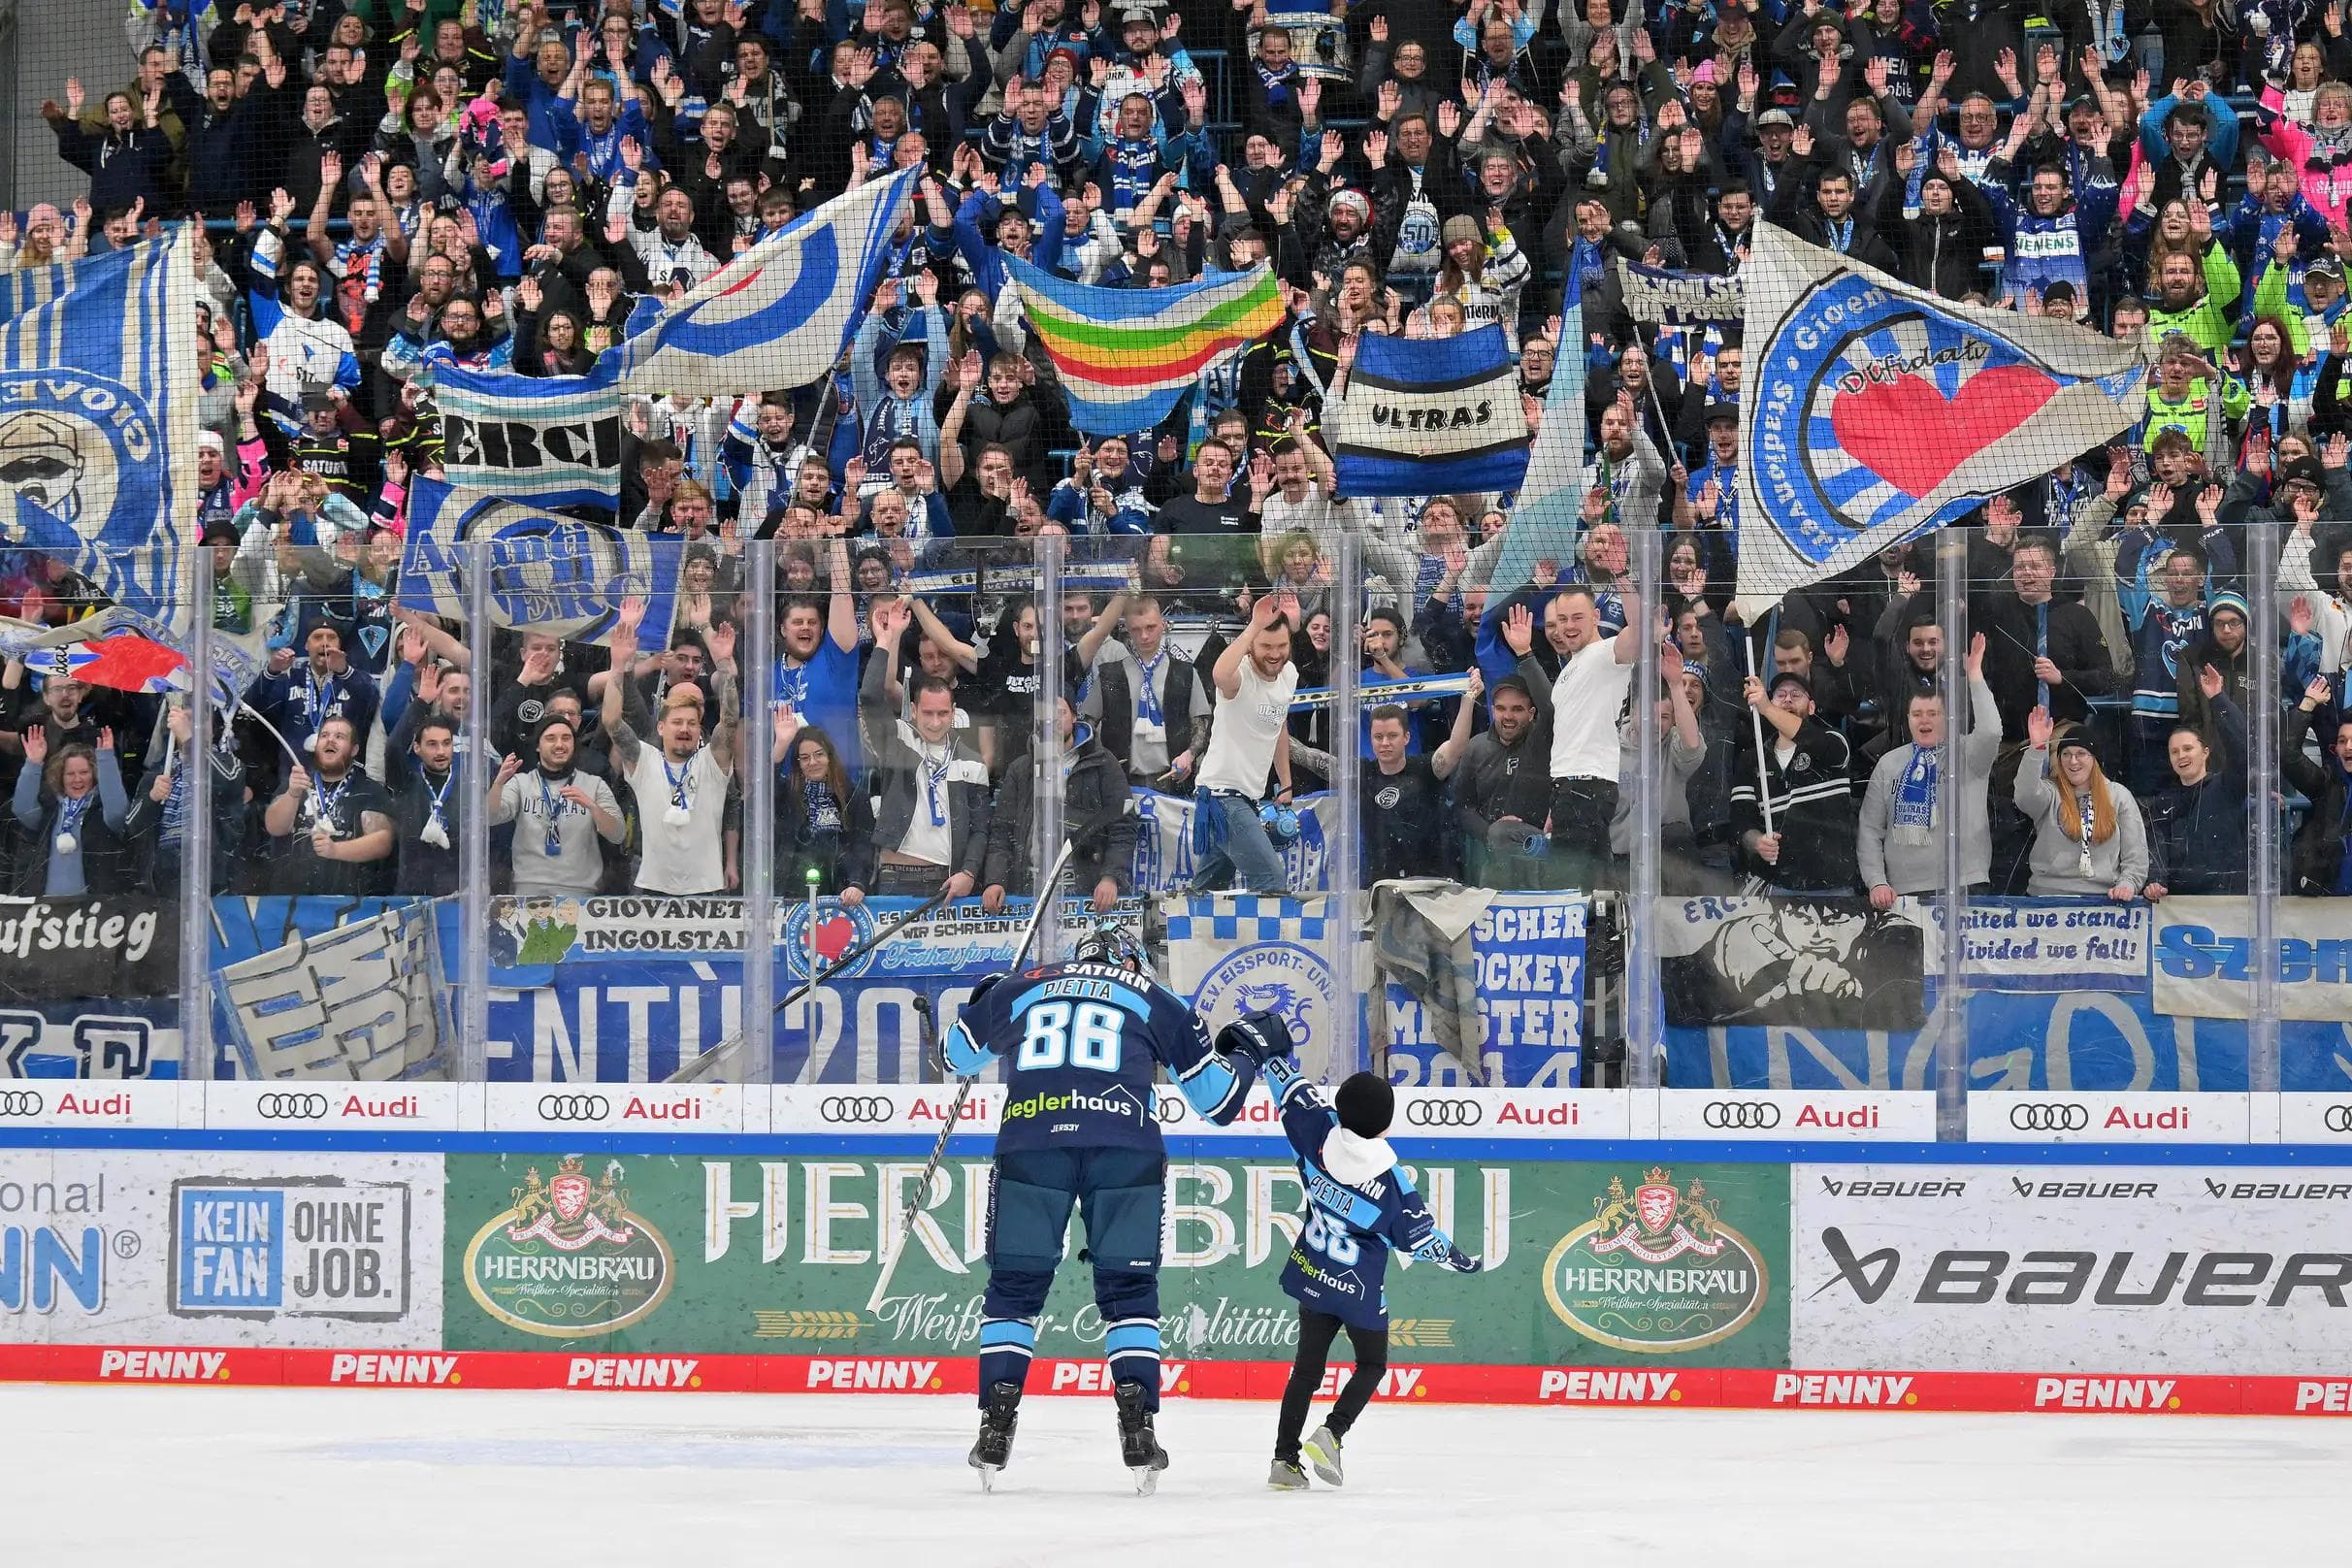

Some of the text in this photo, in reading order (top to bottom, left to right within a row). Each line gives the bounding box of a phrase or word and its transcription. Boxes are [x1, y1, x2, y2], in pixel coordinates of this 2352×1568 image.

[1371, 399, 1495, 431] ULTRAS
[937, 907, 961, 922] AN
[1474, 905, 1586, 942] SCHER
[2026, 913, 2059, 929] we
[2064, 910, 2142, 931] stand!
[933, 920, 1011, 938] SCHREIEN
[2046, 943, 2078, 961] we
[2085, 935, 2138, 962] fall!
[1063, 963, 1152, 994] SATURN
[1219, 951, 1303, 984] EISSPORT-
[1043, 978, 1112, 1000] PIETTA
[1387, 998, 1582, 1047] MSTER
[1017, 1000, 1125, 1072] 86
[56, 1094, 132, 1115] Audi
[342, 1095, 418, 1118] Audi
[623, 1097, 701, 1120] Audi
[908, 1098, 987, 1121] Audi
[1496, 1102, 1579, 1126] Audi
[1795, 1104, 1878, 1128] Audi
[2104, 1106, 2189, 1129] Audi
[1310, 1175, 1355, 1216] PIETTA
[1846, 1181, 1967, 1198] BAUER
[2038, 1182, 2159, 1199] BAUER
[2231, 1184, 2352, 1200] BAUER
[193, 1200, 384, 1245] KEIN OHNE
[701, 1161, 1509, 1275] HERBRU
[1626, 1239, 1683, 1261] INGOLSTADT
[194, 1247, 393, 1299] FAN JOB.
[485, 1255, 654, 1282] HERRNBRÄU
[1565, 1266, 1748, 1295] HERRNBRÄU
[1913, 1250, 2352, 1308] BAUER
